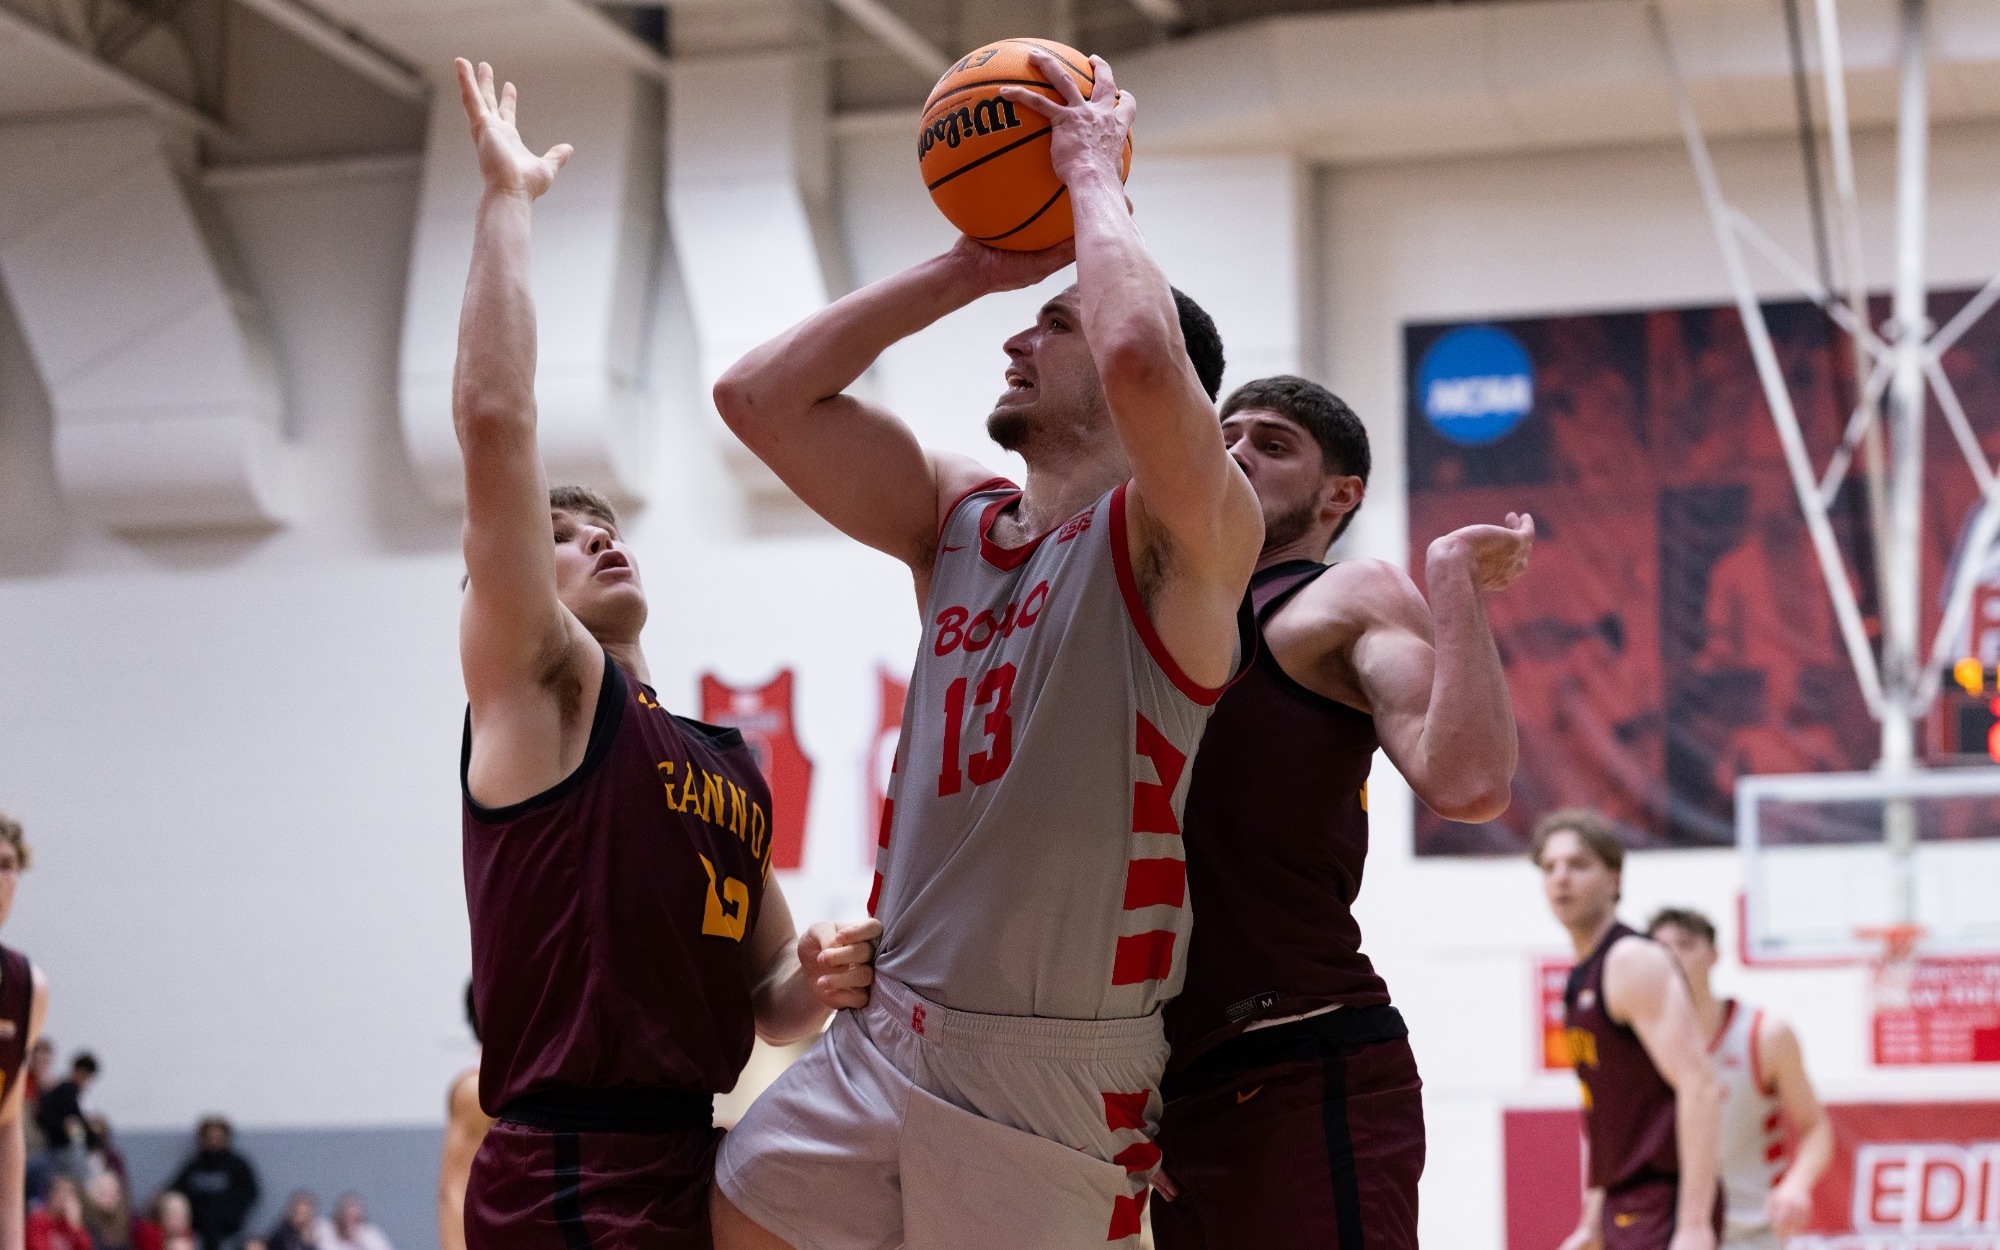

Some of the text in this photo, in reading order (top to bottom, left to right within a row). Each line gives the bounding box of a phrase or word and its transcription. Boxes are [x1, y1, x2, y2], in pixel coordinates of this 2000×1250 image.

[938, 661, 1017, 798] 13
[1262, 998, 1273, 1008] M
[1868, 1158, 2000, 1224] EDI
